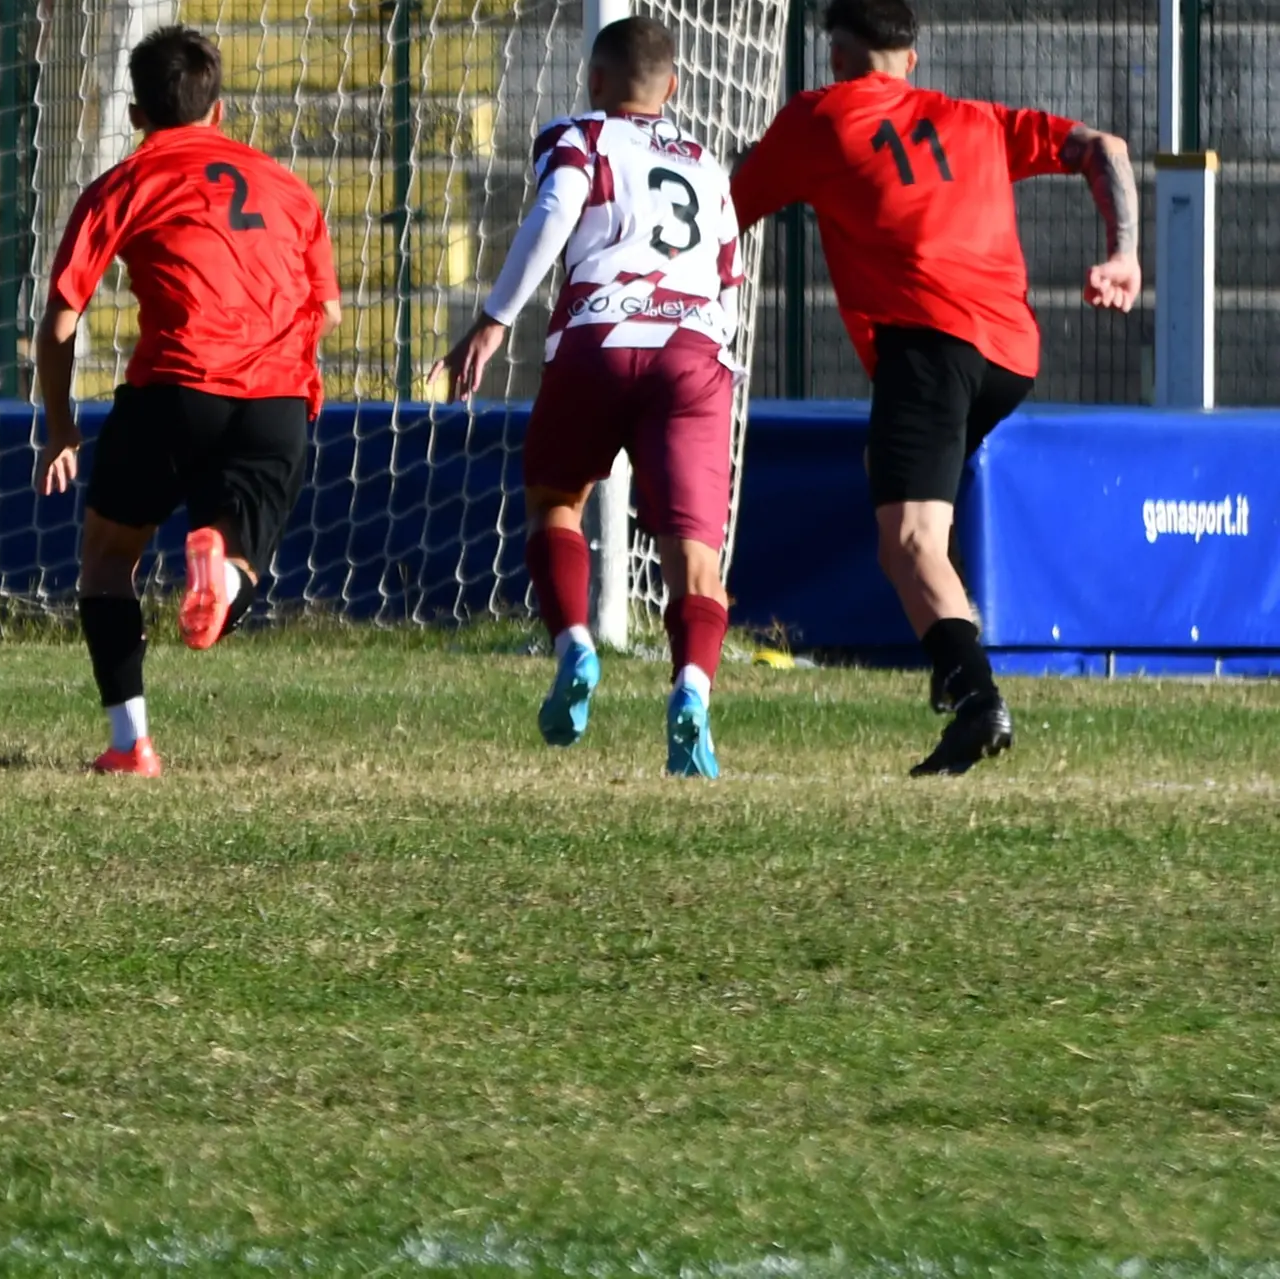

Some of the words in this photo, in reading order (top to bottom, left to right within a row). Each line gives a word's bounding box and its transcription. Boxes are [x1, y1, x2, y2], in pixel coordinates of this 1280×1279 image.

[870, 117, 954, 186] 11
[205, 162, 267, 231] 2
[648, 166, 702, 260] 3
[1142, 493, 1249, 544] ganasport.it
